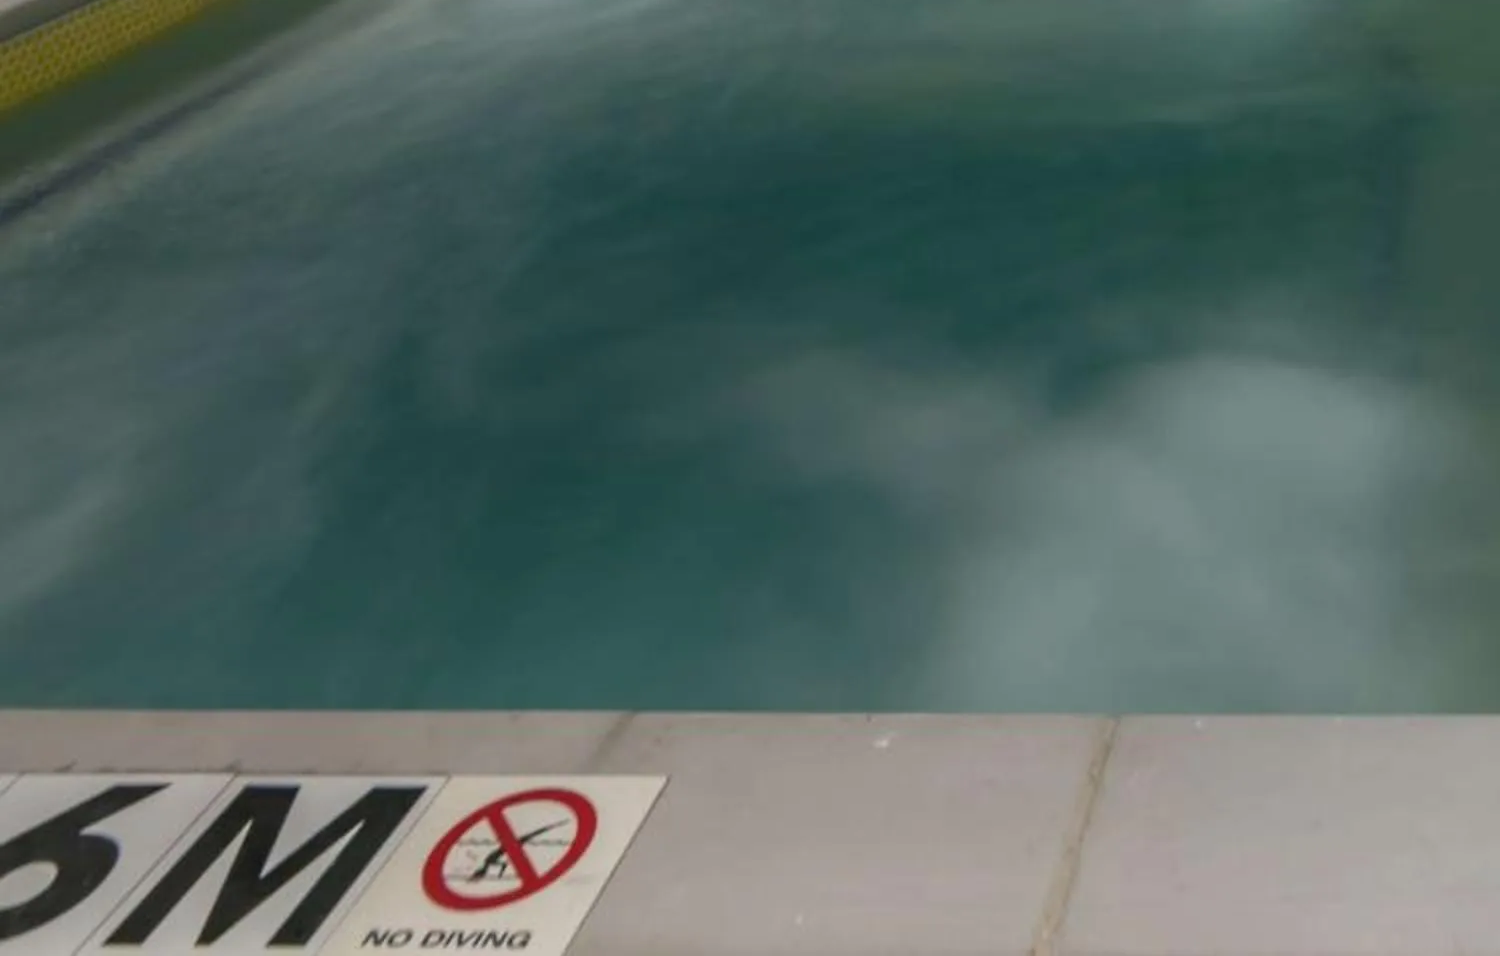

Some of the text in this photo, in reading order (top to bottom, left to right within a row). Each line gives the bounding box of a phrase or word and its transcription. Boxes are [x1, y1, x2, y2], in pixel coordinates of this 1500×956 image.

[102, 785, 428, 948] M
[361, 929, 533, 950] NO DIVING
